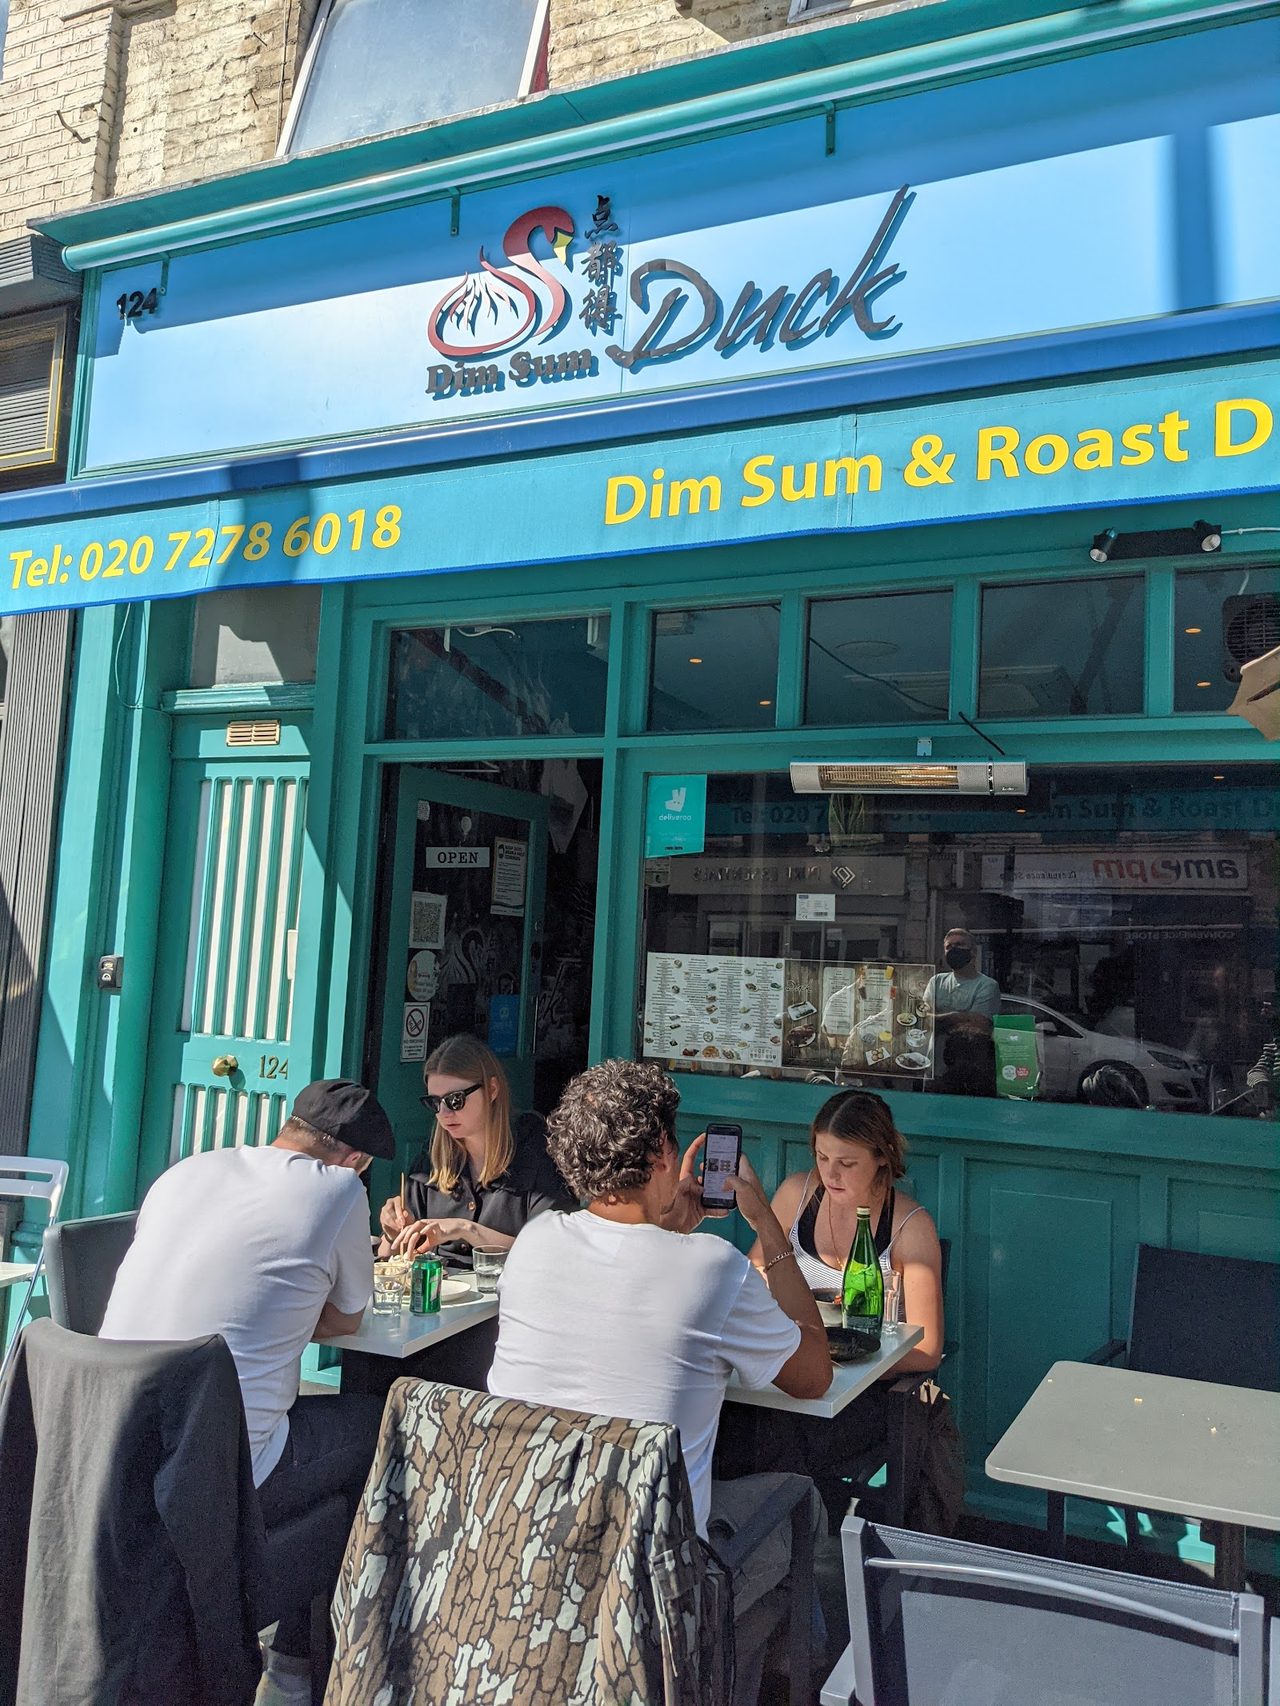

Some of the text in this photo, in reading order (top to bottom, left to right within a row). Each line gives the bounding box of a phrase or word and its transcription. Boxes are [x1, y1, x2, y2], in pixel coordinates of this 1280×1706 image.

[606, 184, 909, 367] Duck
[116, 288, 159, 319] 124
[425, 348, 594, 394] Dim Sum
[604, 397, 1273, 526] Dim Sum & Roast D
[9, 504, 403, 589] Tel: 020 7278 6018
[437, 851, 479, 864] OPEN
[259, 1055, 288, 1079] 124
